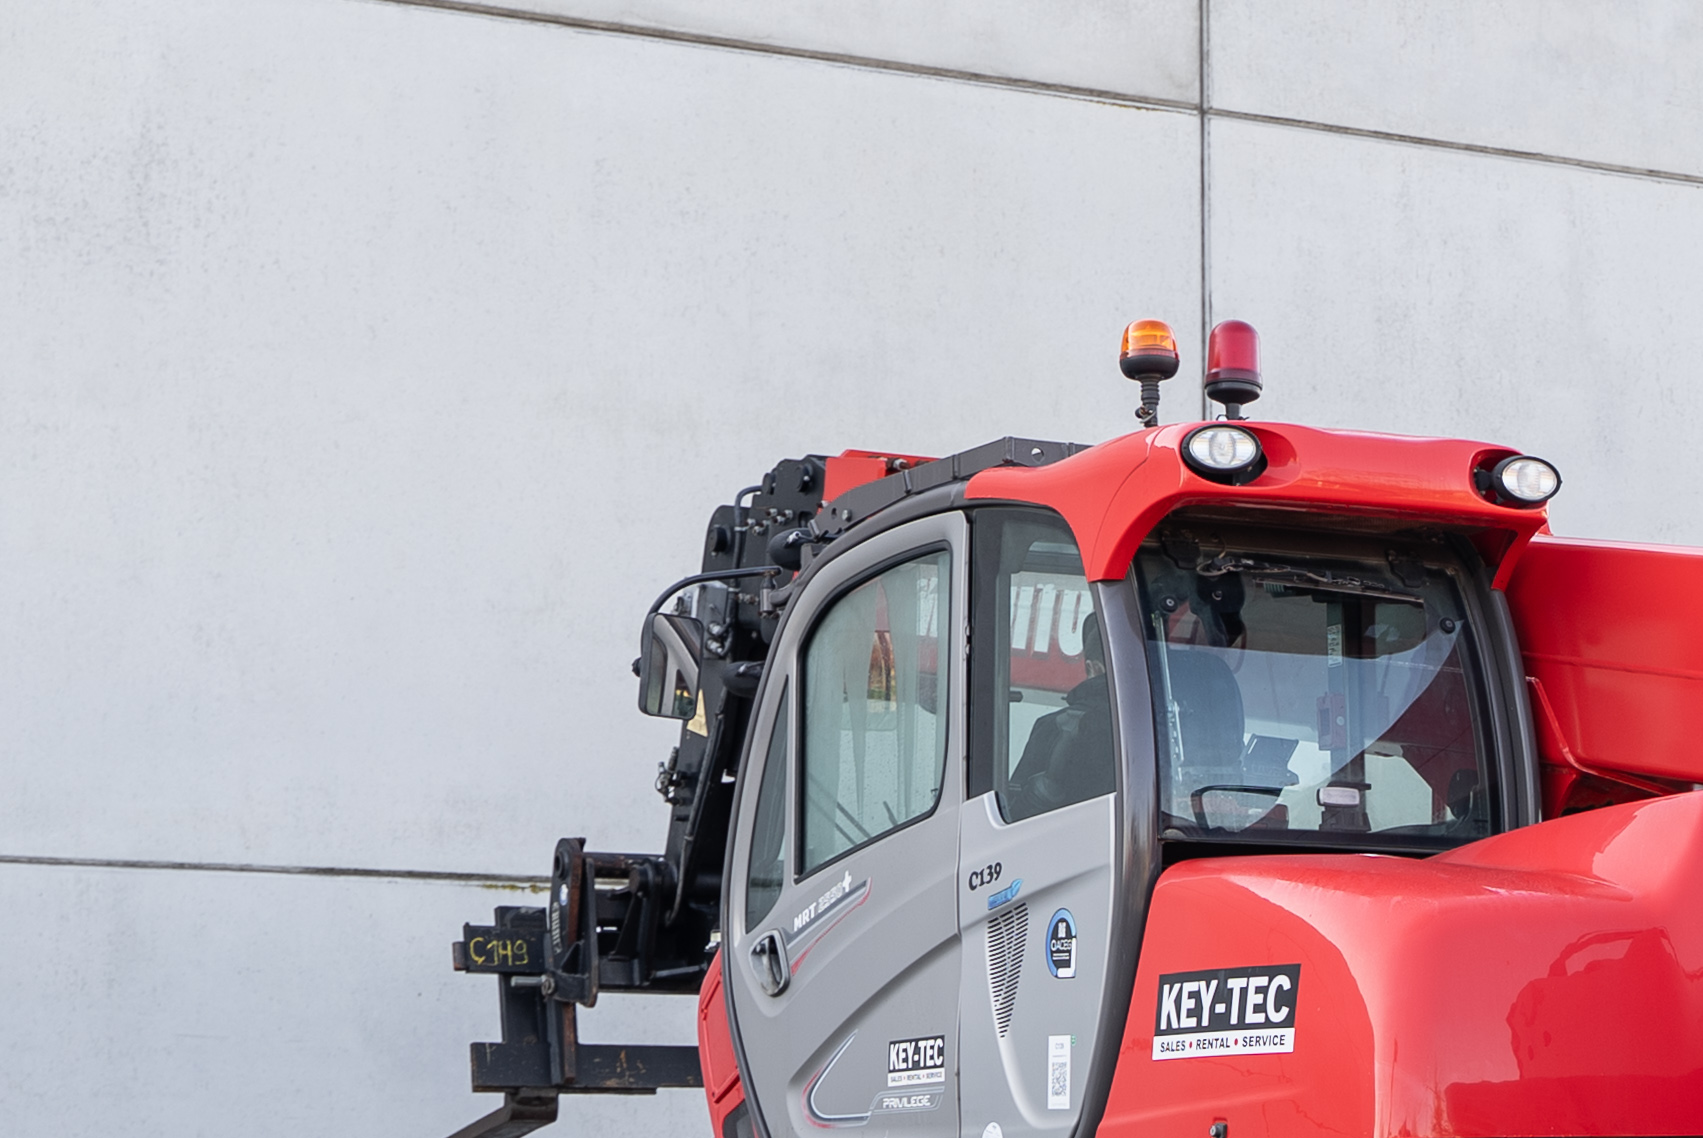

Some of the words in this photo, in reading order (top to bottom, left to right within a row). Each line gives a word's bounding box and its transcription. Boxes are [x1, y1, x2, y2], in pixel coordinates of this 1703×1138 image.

[793, 902, 817, 932] MRT
[1159, 974, 1292, 1031] KEY-TEC
[889, 1038, 944, 1071] KEY-TEC
[1160, 1040, 1186, 1053] SALES
[1195, 1038, 1231, 1050] RENTAL
[1242, 1035, 1286, 1048] SERVICE
